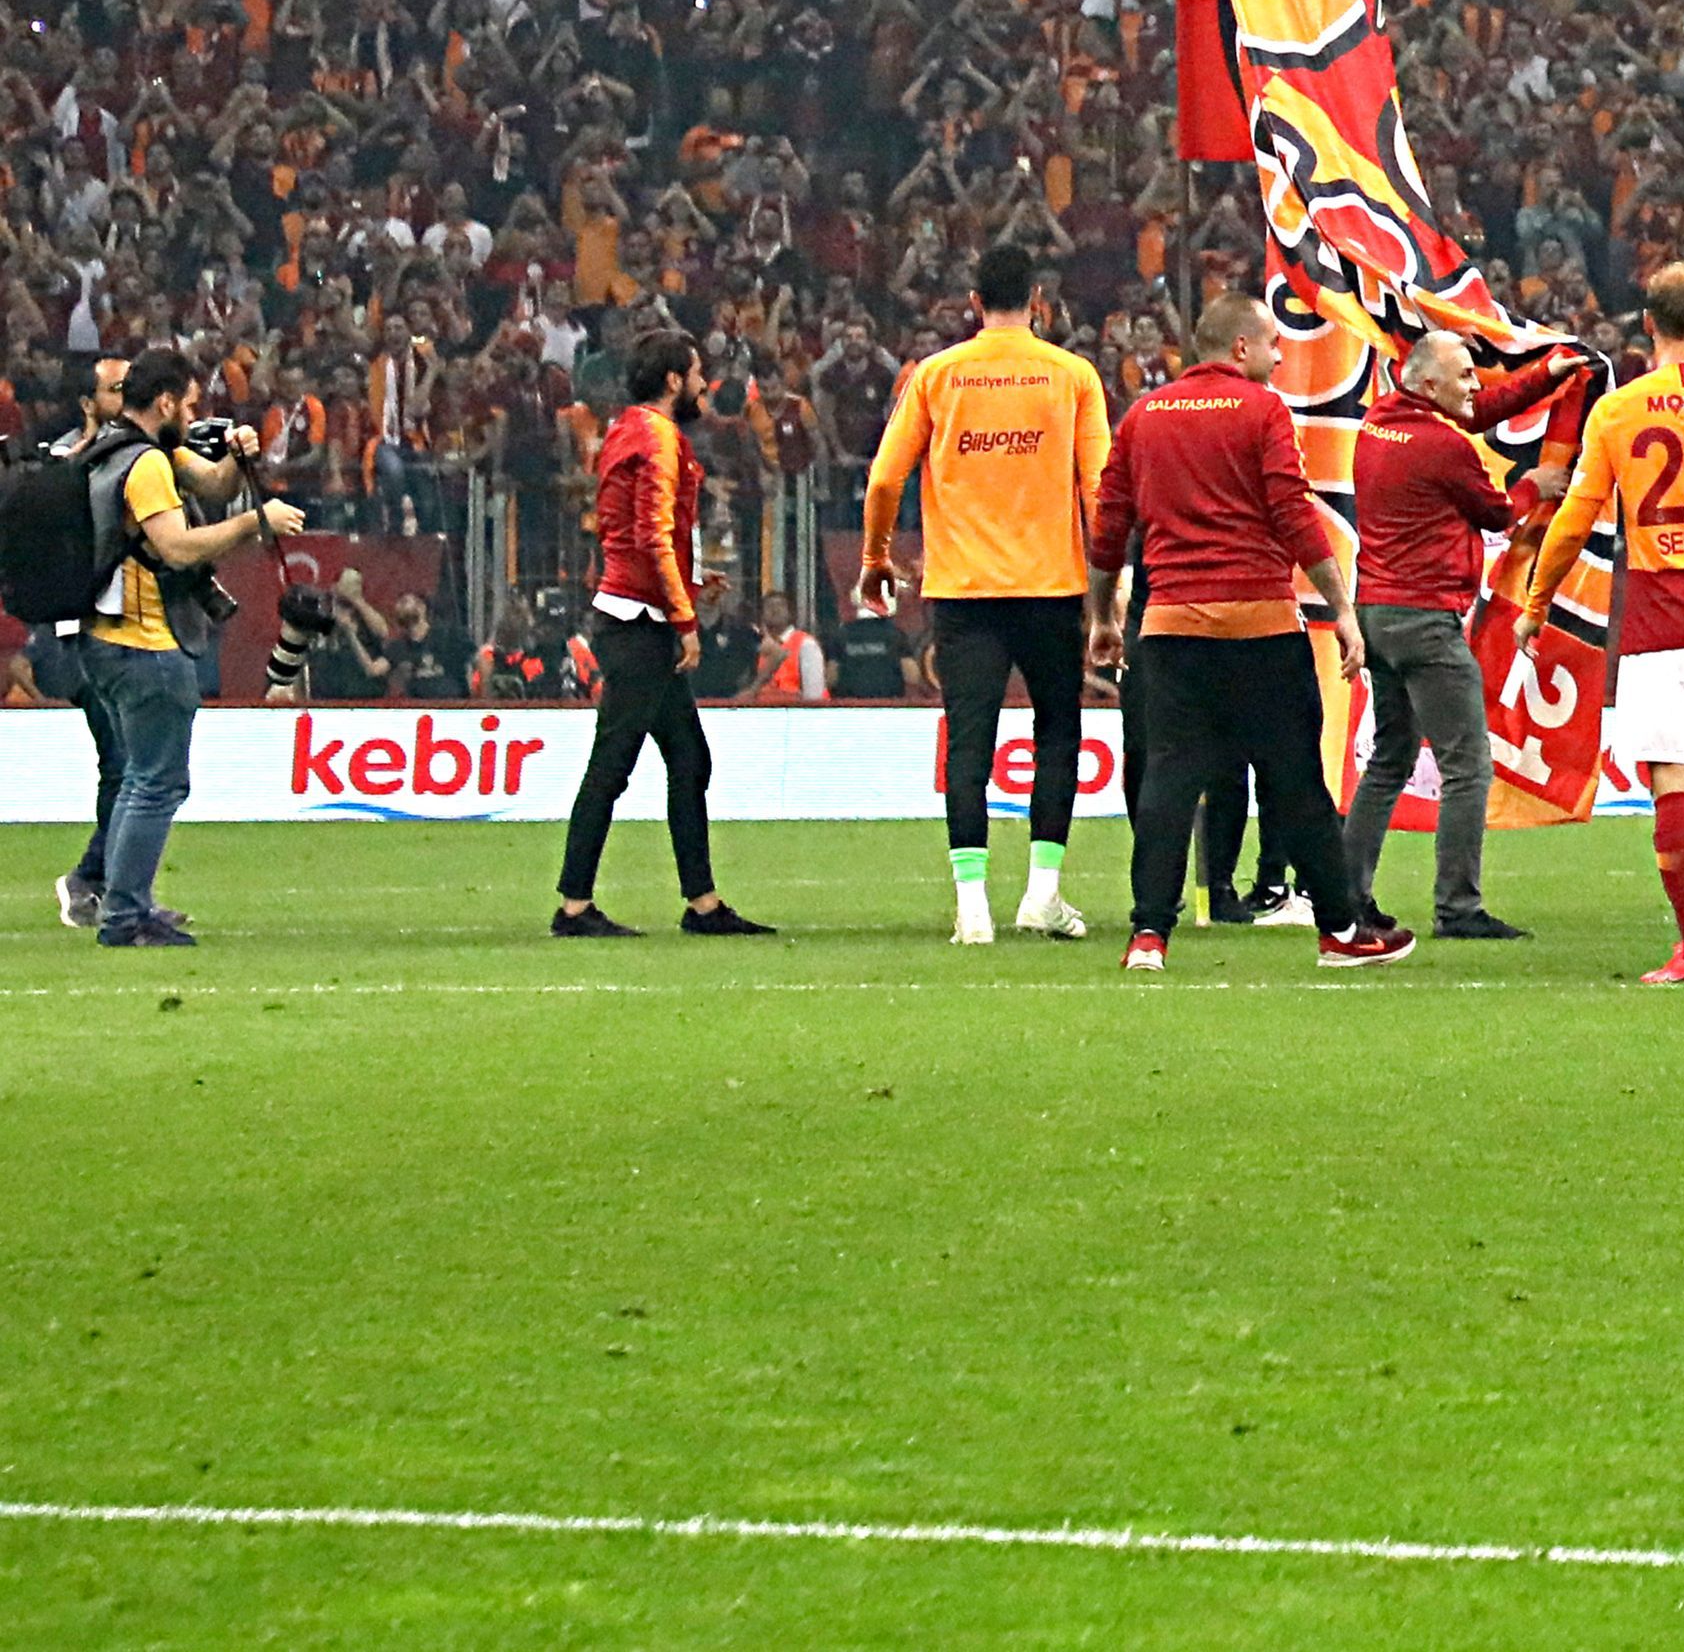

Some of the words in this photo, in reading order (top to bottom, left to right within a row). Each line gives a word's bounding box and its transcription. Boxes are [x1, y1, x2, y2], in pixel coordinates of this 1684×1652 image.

[951, 375, 1050, 389] ikinciyeni.com
[1145, 397, 1244, 412] GALATASARAY
[957, 429, 1045, 456] Bilyoner
[1361, 420, 1414, 444] ATASARAY
[291, 714, 545, 795] kebir
